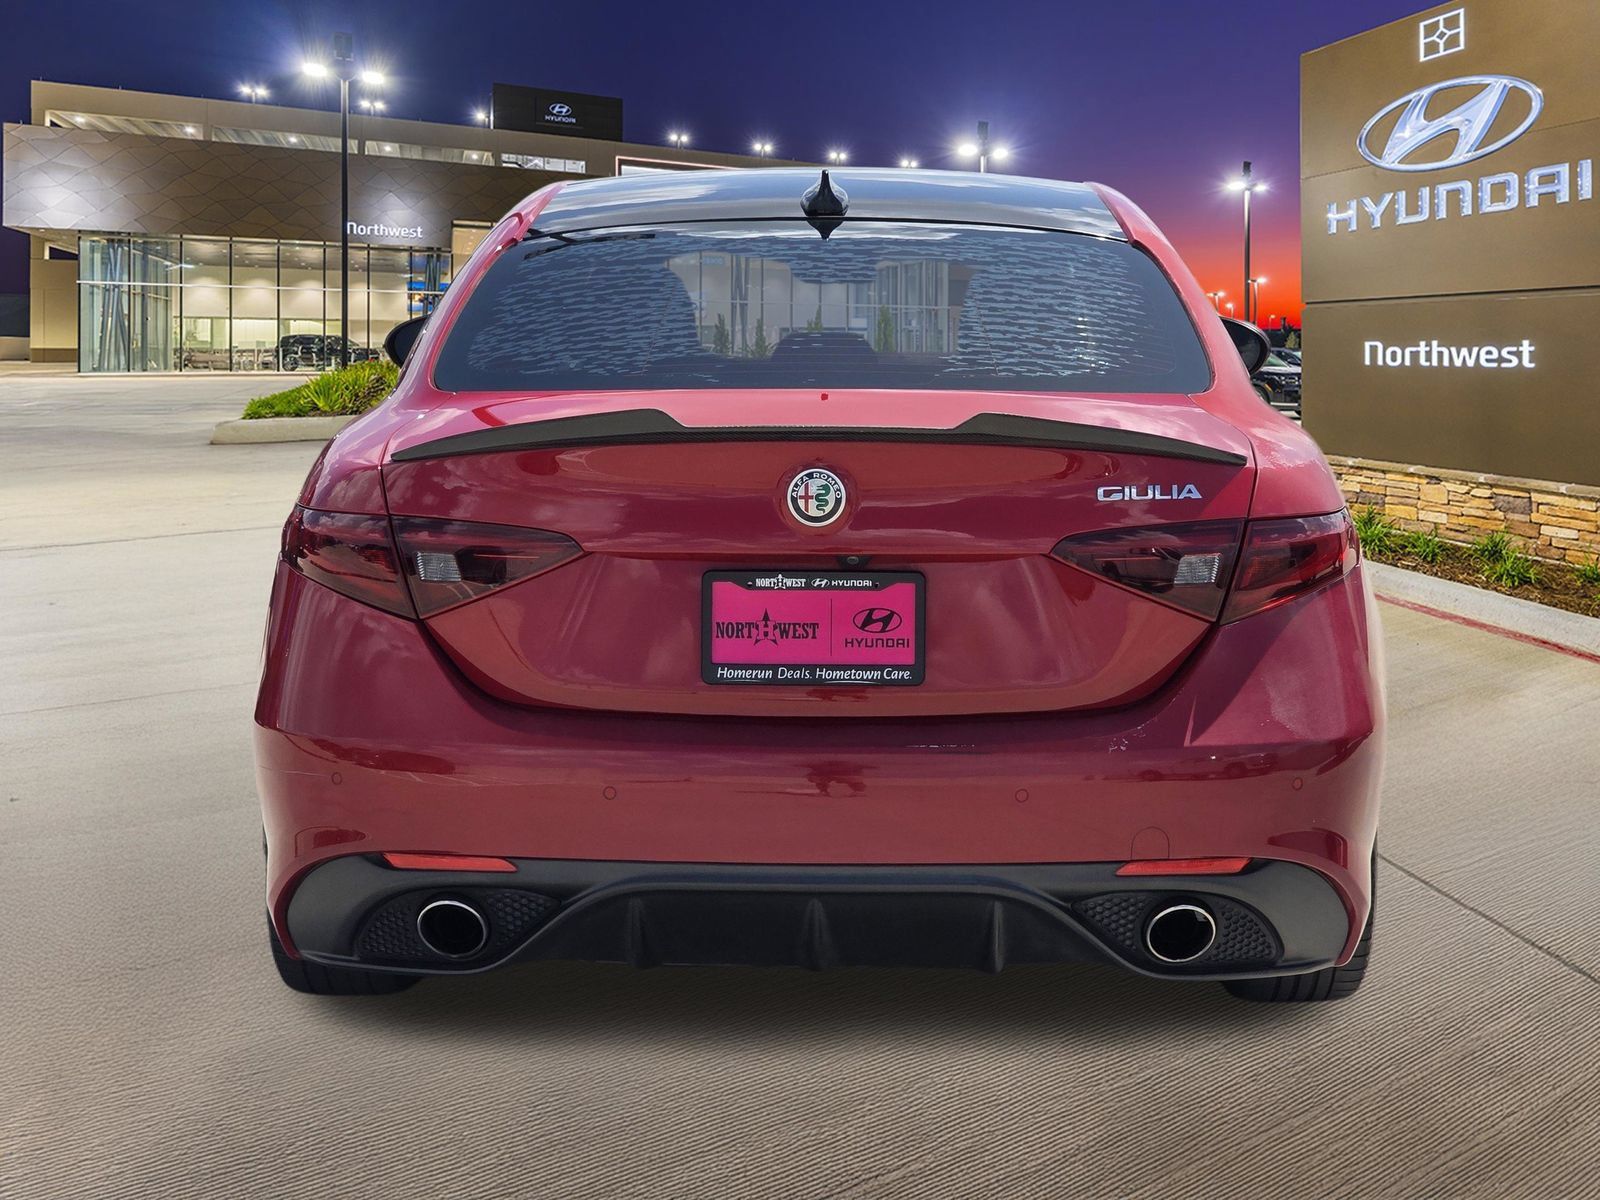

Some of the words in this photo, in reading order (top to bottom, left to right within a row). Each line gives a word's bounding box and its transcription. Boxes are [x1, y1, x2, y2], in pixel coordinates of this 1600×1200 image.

[1327, 159, 1593, 235] HYUNDAI
[1364, 340, 1536, 368] Northwest
[792, 475, 810, 498] ALFA
[813, 472, 842, 499] ROMEO
[1097, 484, 1202, 501] GIULIA
[831, 579, 873, 587] HYUNDAI
[845, 637, 910, 649] HYUNDAI
[717, 666, 773, 680] Homerun
[777, 667, 813, 680] Deals.
[816, 667, 881, 681] Hometown
[883, 668, 912, 680] Care.
